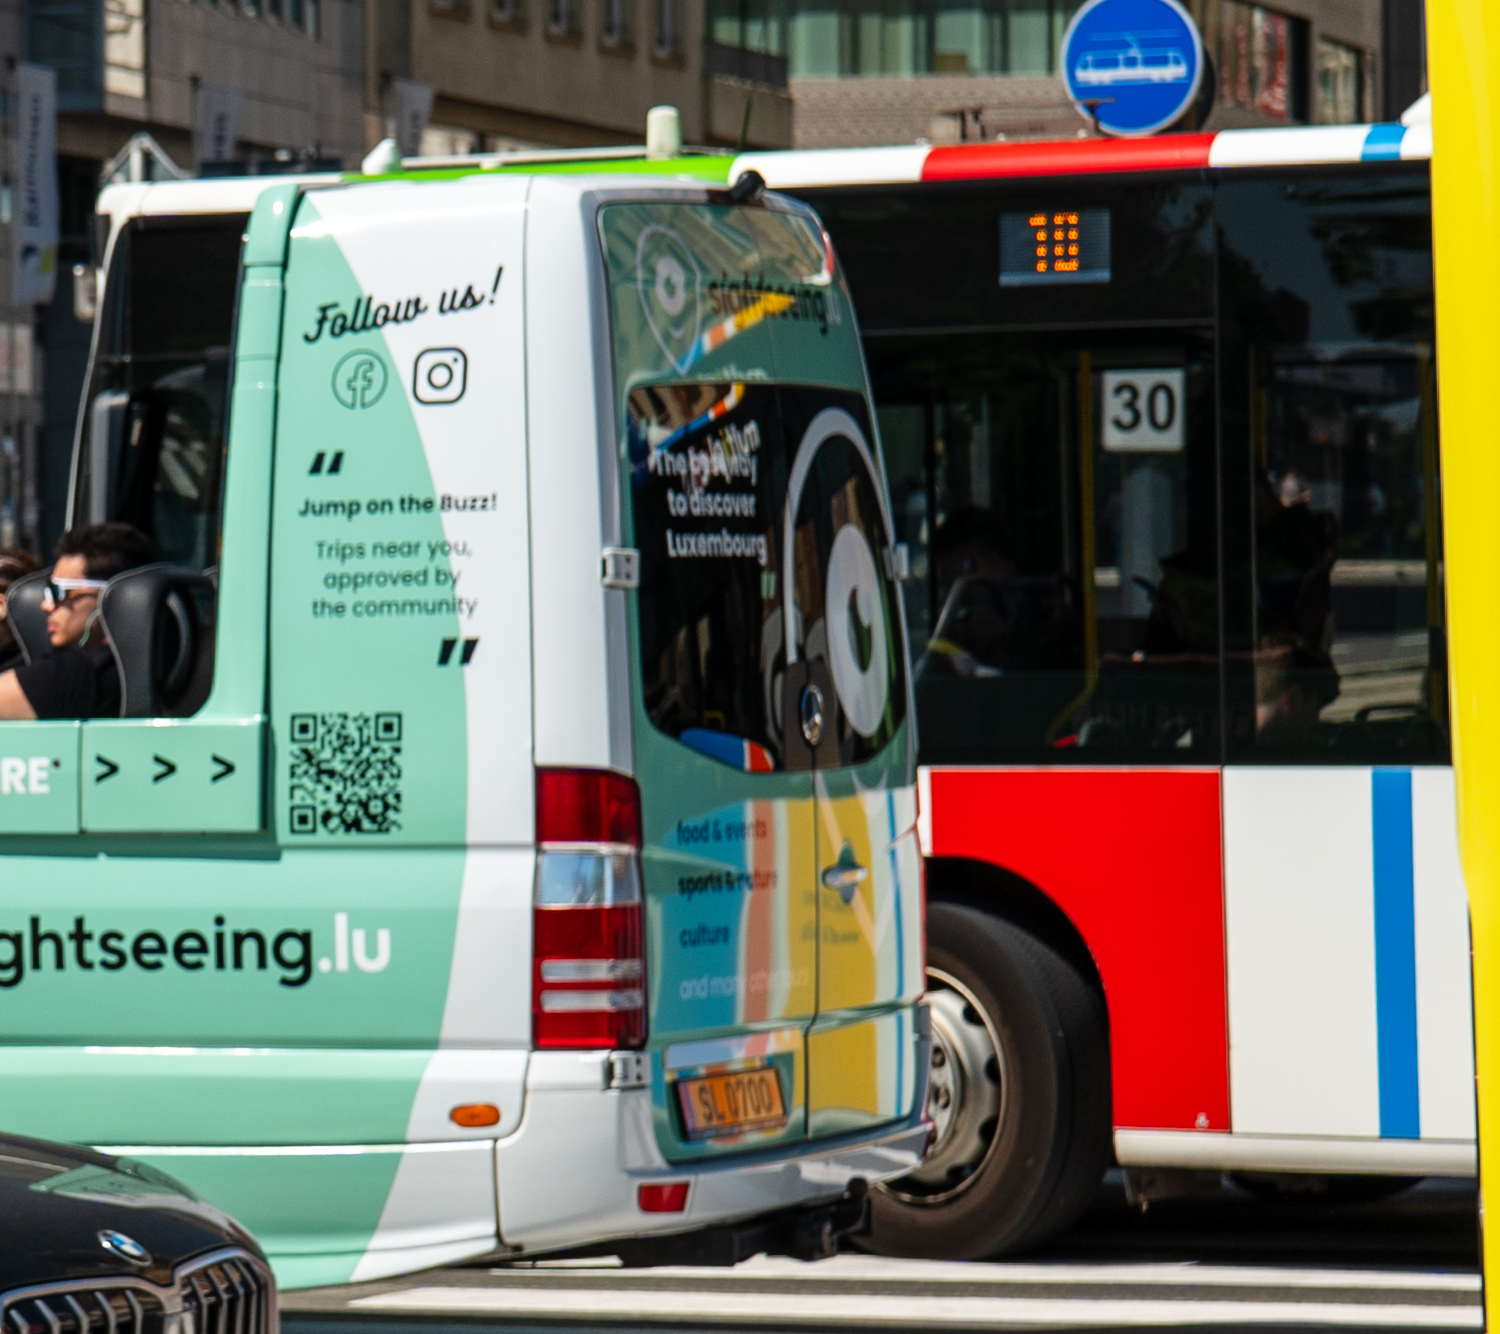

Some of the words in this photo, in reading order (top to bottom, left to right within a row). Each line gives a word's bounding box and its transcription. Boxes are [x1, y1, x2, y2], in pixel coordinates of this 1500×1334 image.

[303, 295, 428, 343] Follow
[439, 264, 503, 314] us!
[1111, 382, 1175, 430] 30
[655, 448, 687, 476] The
[298, 498, 361, 522] Jump
[366, 498, 394, 515] on
[400, 493, 435, 513] the
[441, 492, 498, 512] Buzz!
[667, 489, 688, 516] to
[690, 488, 757, 517] discover
[316, 539, 366, 565] Trips
[372, 540, 421, 559] near
[426, 540, 472, 563] you,
[666, 527, 768, 566] Luxembourg
[323, 566, 428, 593] approved
[435, 566, 462, 593] by
[312, 598, 347, 618] the
[352, 596, 477, 619] community
[677, 819, 709, 844] food
[679, 871, 722, 902] sports
[679, 922, 730, 949] culture
[699, 1083, 725, 1124] SL
[725, 1075, 773, 1119] 0700
